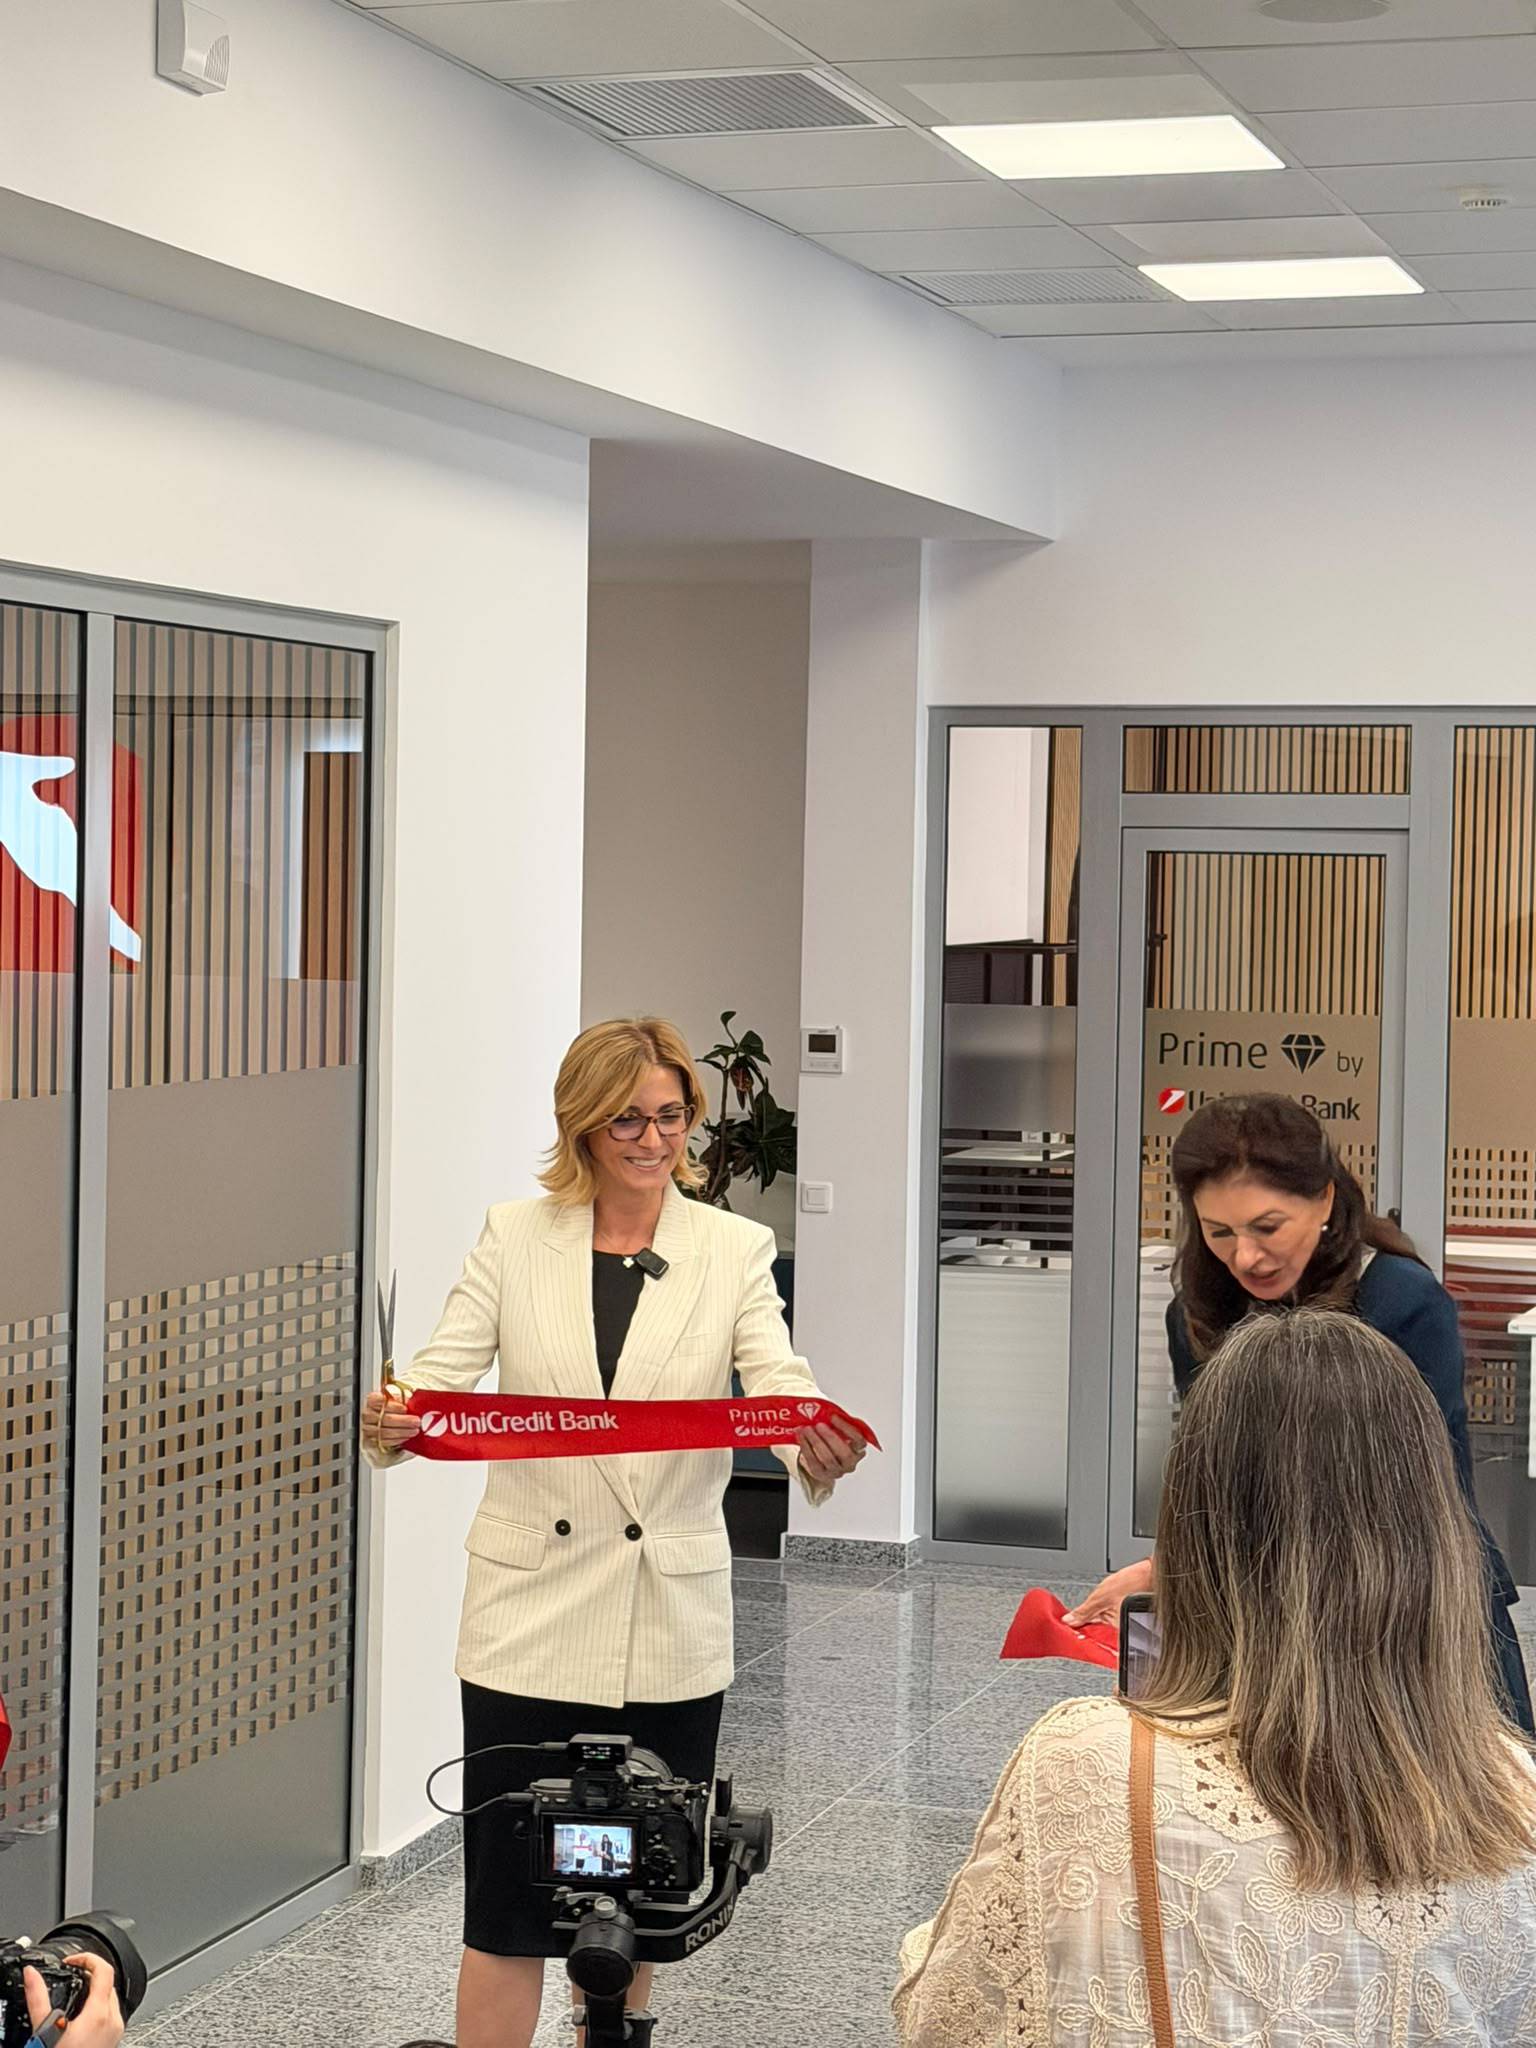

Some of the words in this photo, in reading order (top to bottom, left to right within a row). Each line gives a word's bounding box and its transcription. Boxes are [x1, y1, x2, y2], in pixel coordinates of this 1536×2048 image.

[1159, 1032, 1268, 1069] Prime
[1337, 1051, 1364, 1078] by
[1302, 1094, 1360, 1121] Bank
[450, 1411, 555, 1435] UniCredit
[559, 1410, 619, 1431] Bank
[729, 1408, 791, 1422] Prime
[751, 1425, 796, 1436] UniCre
[685, 1896, 734, 1953] RONIN
